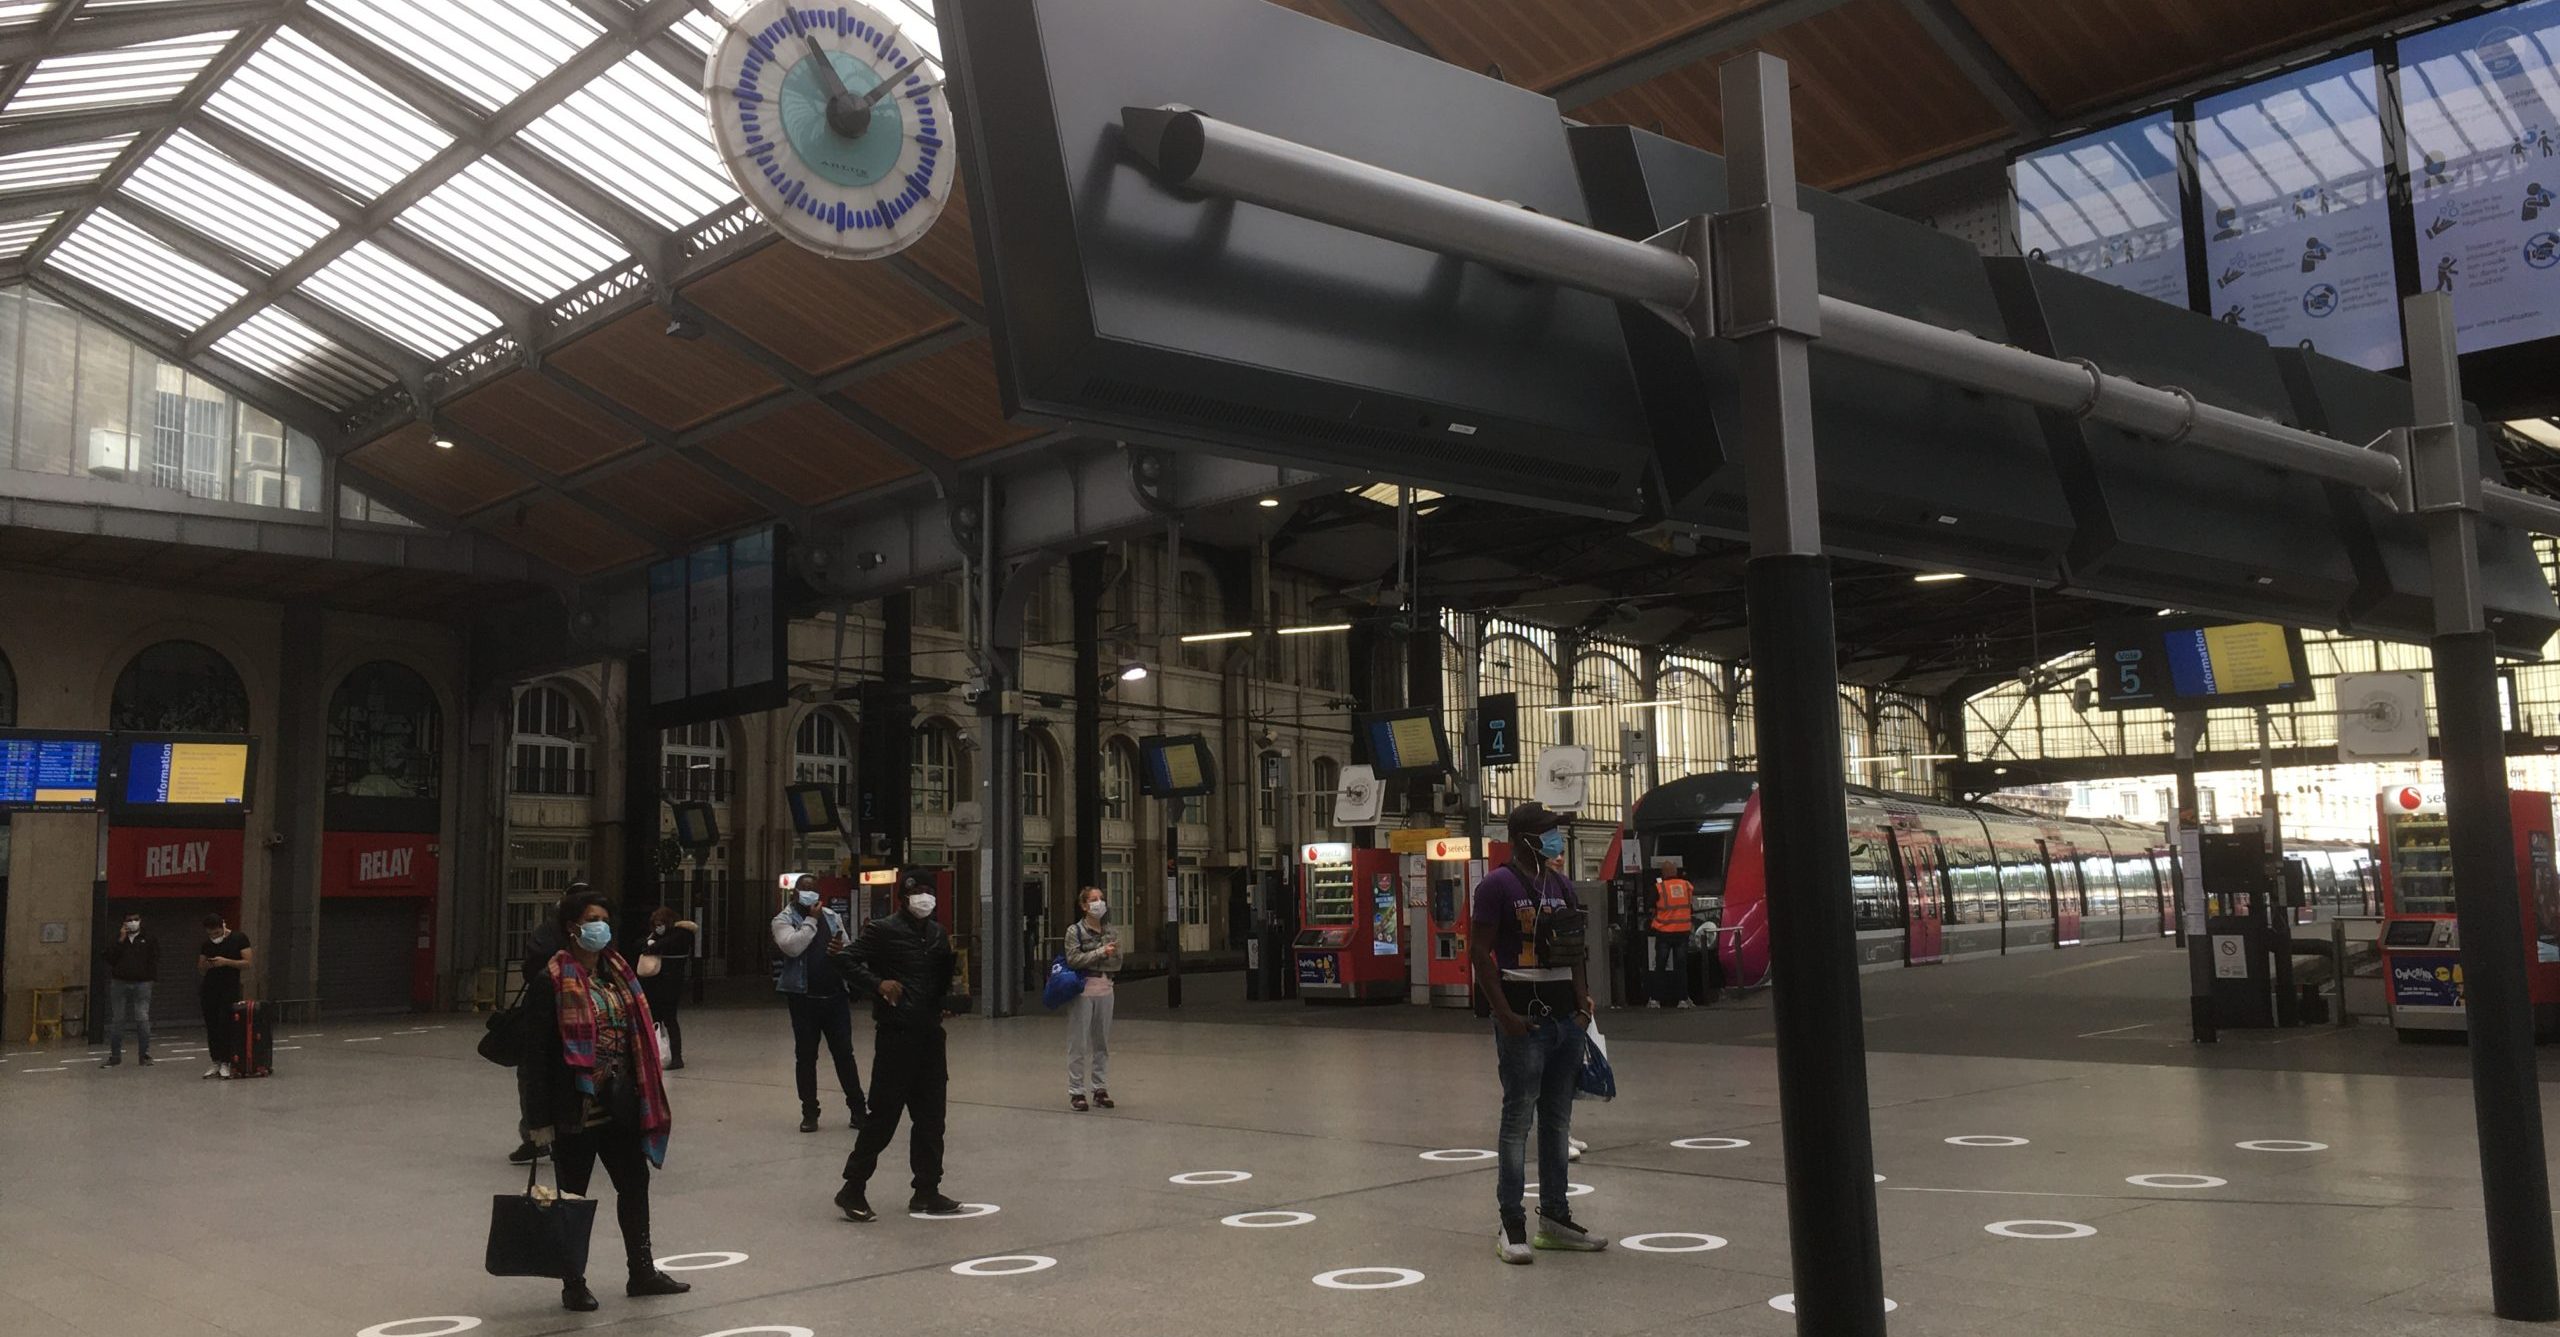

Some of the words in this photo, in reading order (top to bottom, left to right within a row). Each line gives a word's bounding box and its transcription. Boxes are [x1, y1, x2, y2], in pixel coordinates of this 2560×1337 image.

[2120, 664, 2141, 693] 5
[2194, 628, 2216, 695] Information
[1493, 731, 1505, 753] 4
[156, 743, 172, 803] Information
[146, 841, 210, 878] RELAY
[360, 847, 414, 882] RELAY
